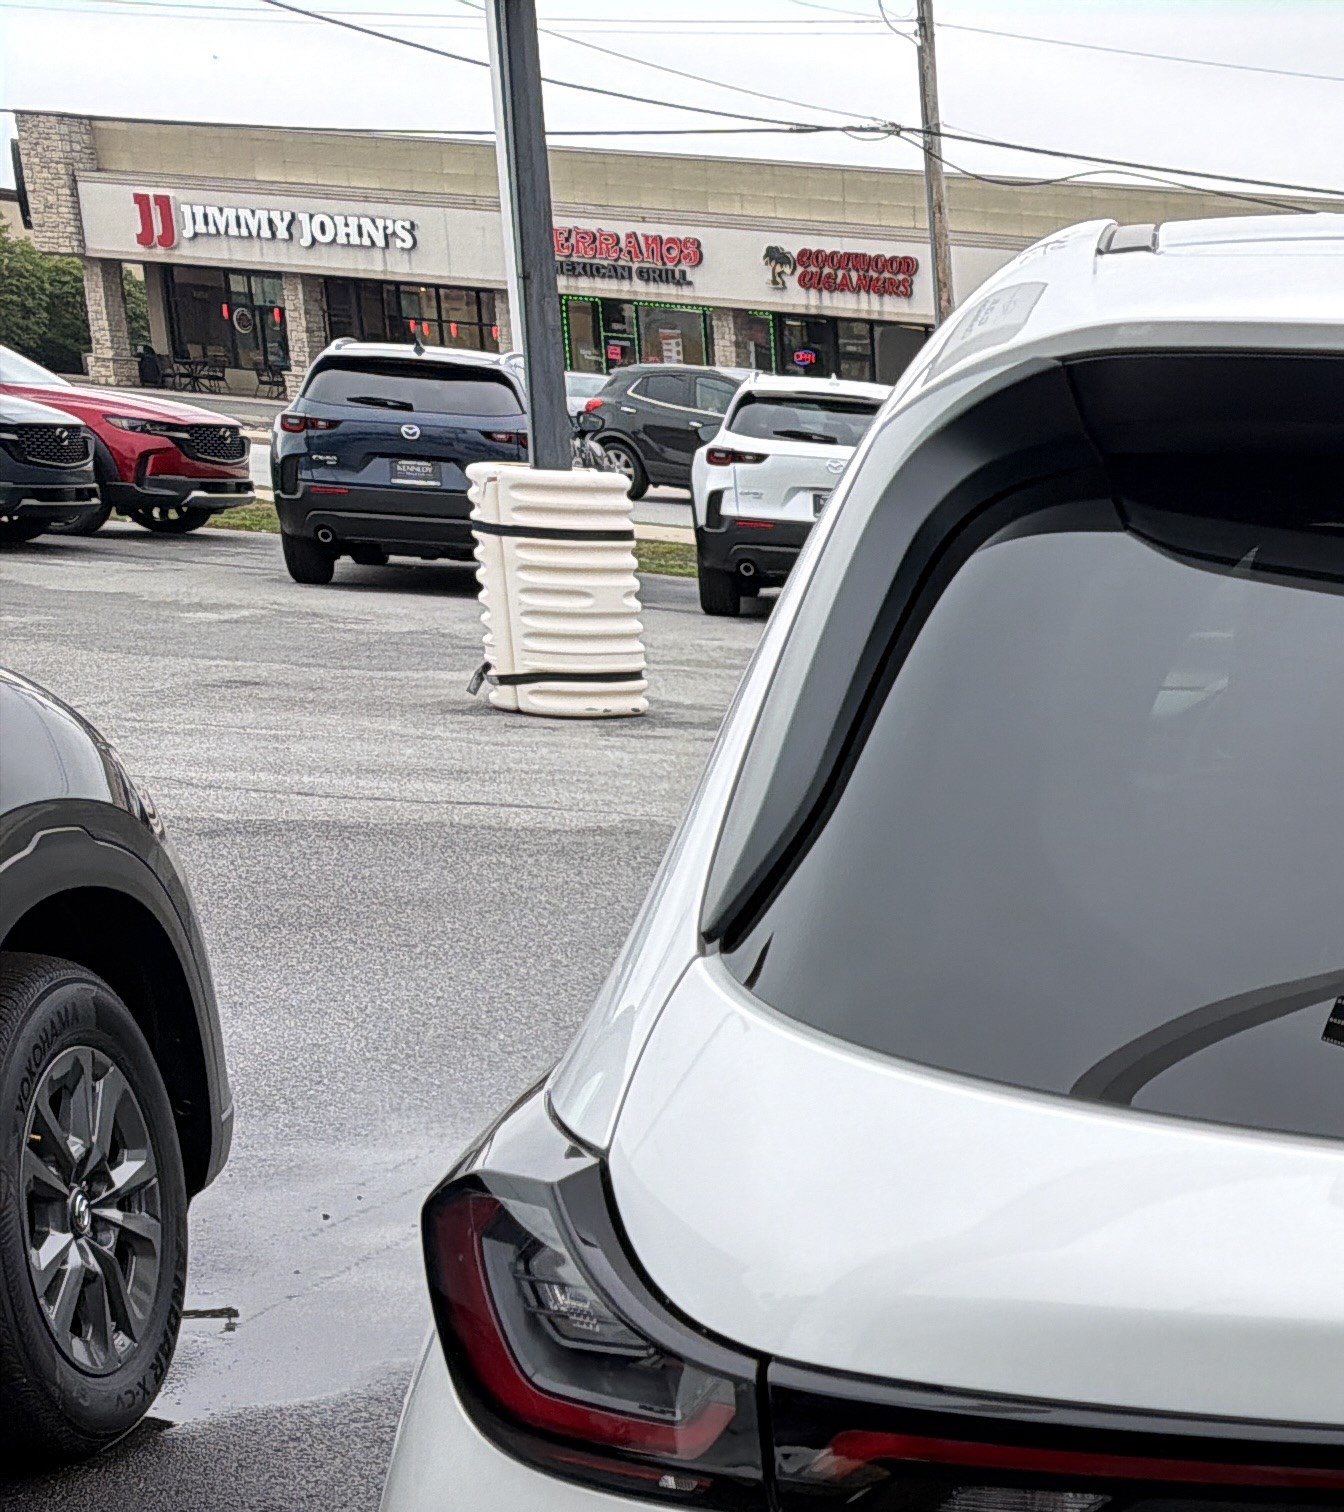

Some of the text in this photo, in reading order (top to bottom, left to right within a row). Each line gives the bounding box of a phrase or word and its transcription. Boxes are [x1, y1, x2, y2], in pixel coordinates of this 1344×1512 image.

[180, 204, 417, 250] JIMMY JOHN'S
[553, 226, 703, 267] ERRANOS
[797, 247, 920, 277] COOLWOOD
[634, 265, 694, 287] GRILL
[798, 270, 915, 299] CLEANERS
[15, 1001, 80, 1114] YOKOHAMA
